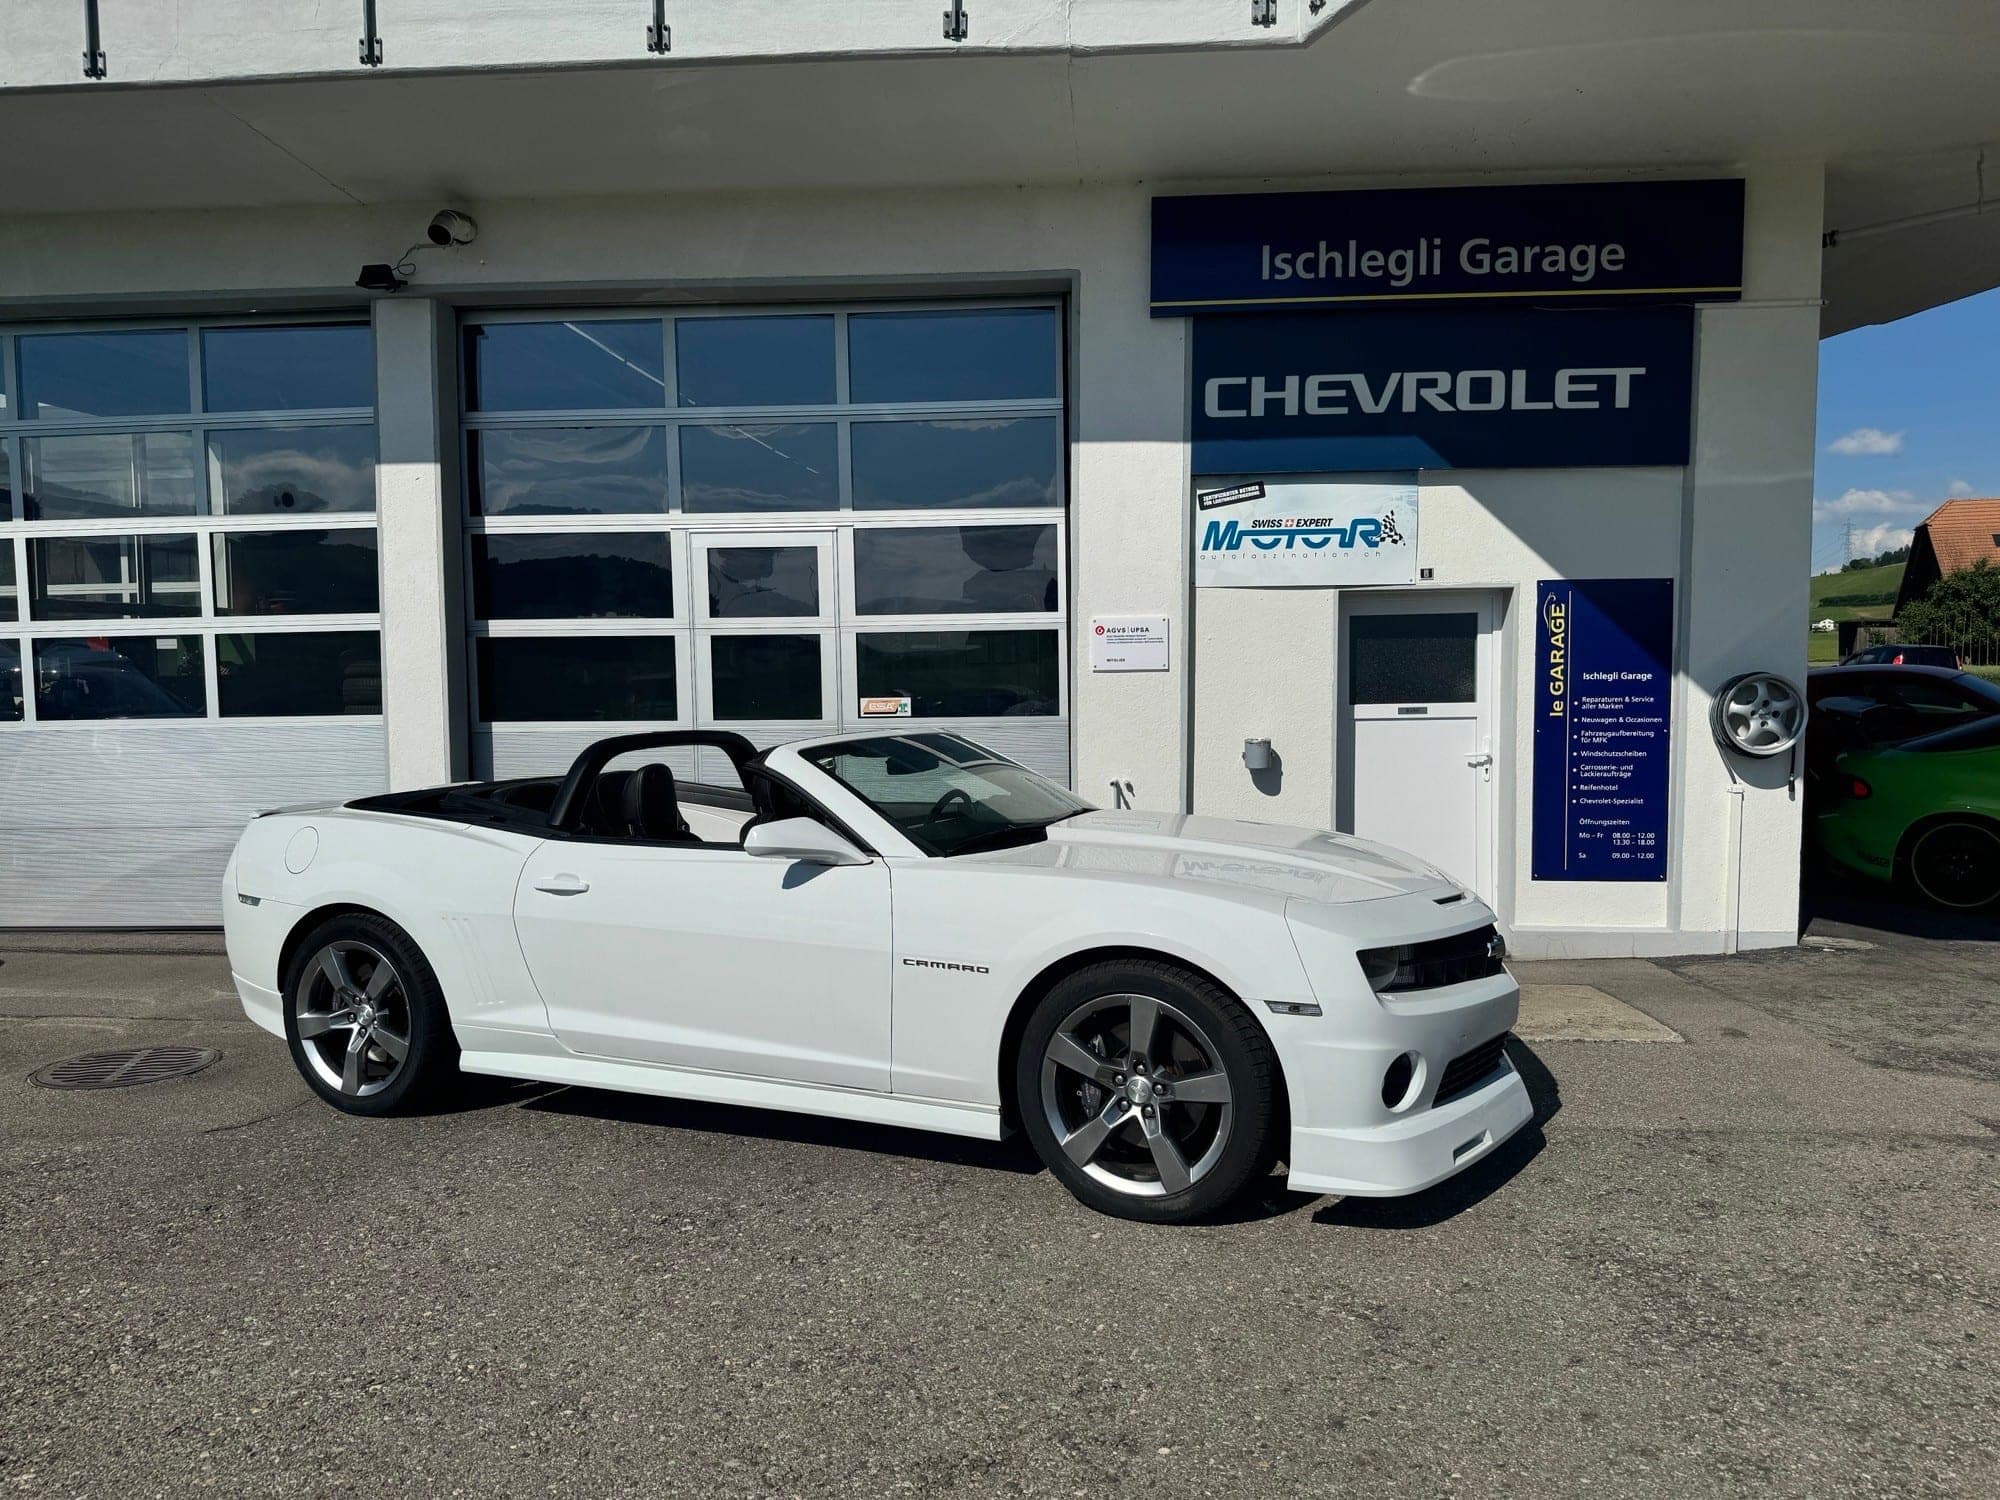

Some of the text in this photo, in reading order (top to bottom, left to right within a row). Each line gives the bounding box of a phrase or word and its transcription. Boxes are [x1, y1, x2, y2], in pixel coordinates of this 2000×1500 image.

[1261, 237, 1626, 287] Ischlegli Garage
[1204, 367, 1647, 419] CHEVROLET
[1251, 517, 1334, 529] SWISS EXPERT
[1549, 603, 1565, 717] le GARAGE
[1583, 672, 1653, 682] Ischlegli Garage
[1581, 696, 1623, 704] Reparaturen
[1581, 730, 1655, 738] Fahrzeugaufbereitung
[1580, 771, 1632, 779] Lackieraufträge
[1579, 797, 1644, 805] Chevrolet-Spezialist
[1579, 817, 1630, 827] Öffnungszeiten
[902, 958, 990, 974] CAMARO
